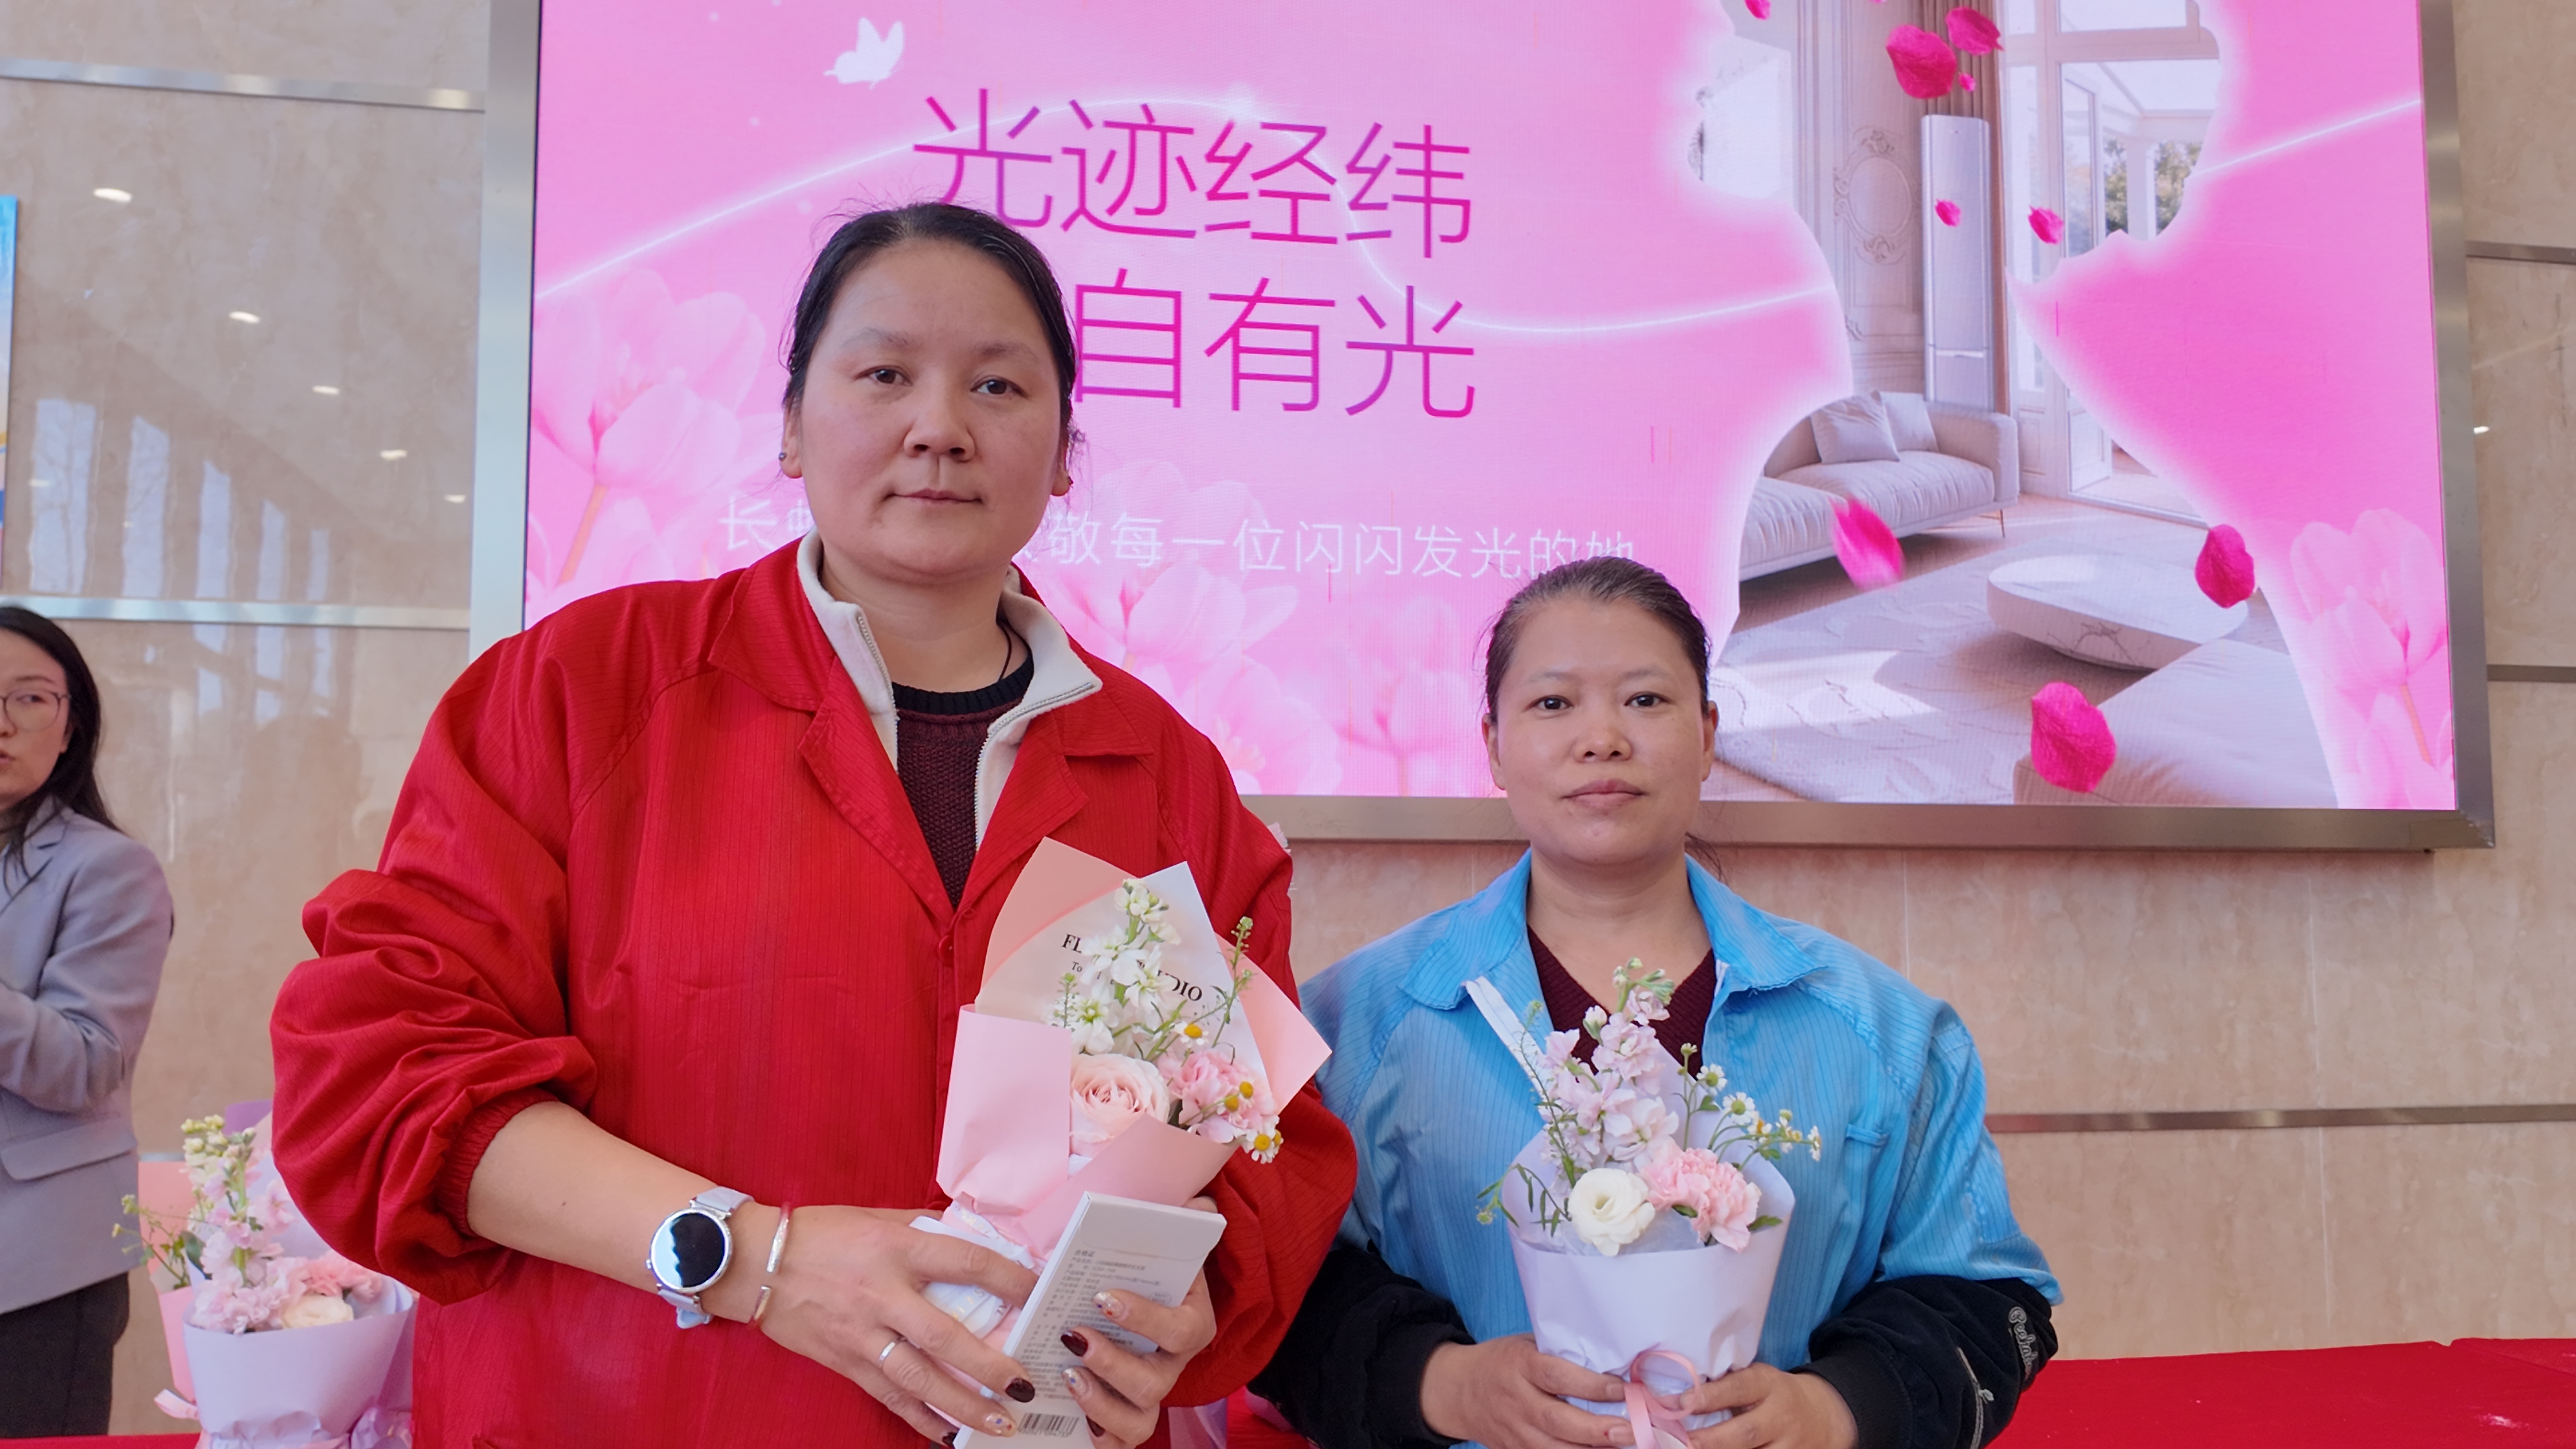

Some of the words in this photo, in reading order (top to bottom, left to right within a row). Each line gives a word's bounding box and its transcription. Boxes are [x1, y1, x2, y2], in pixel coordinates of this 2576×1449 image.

[913, 88, 1472, 259] 光迹经纬
[1075, 268, 1475, 419] 自有光
[1024, 511, 1633, 581] 敬每一位闪闪发光的她
